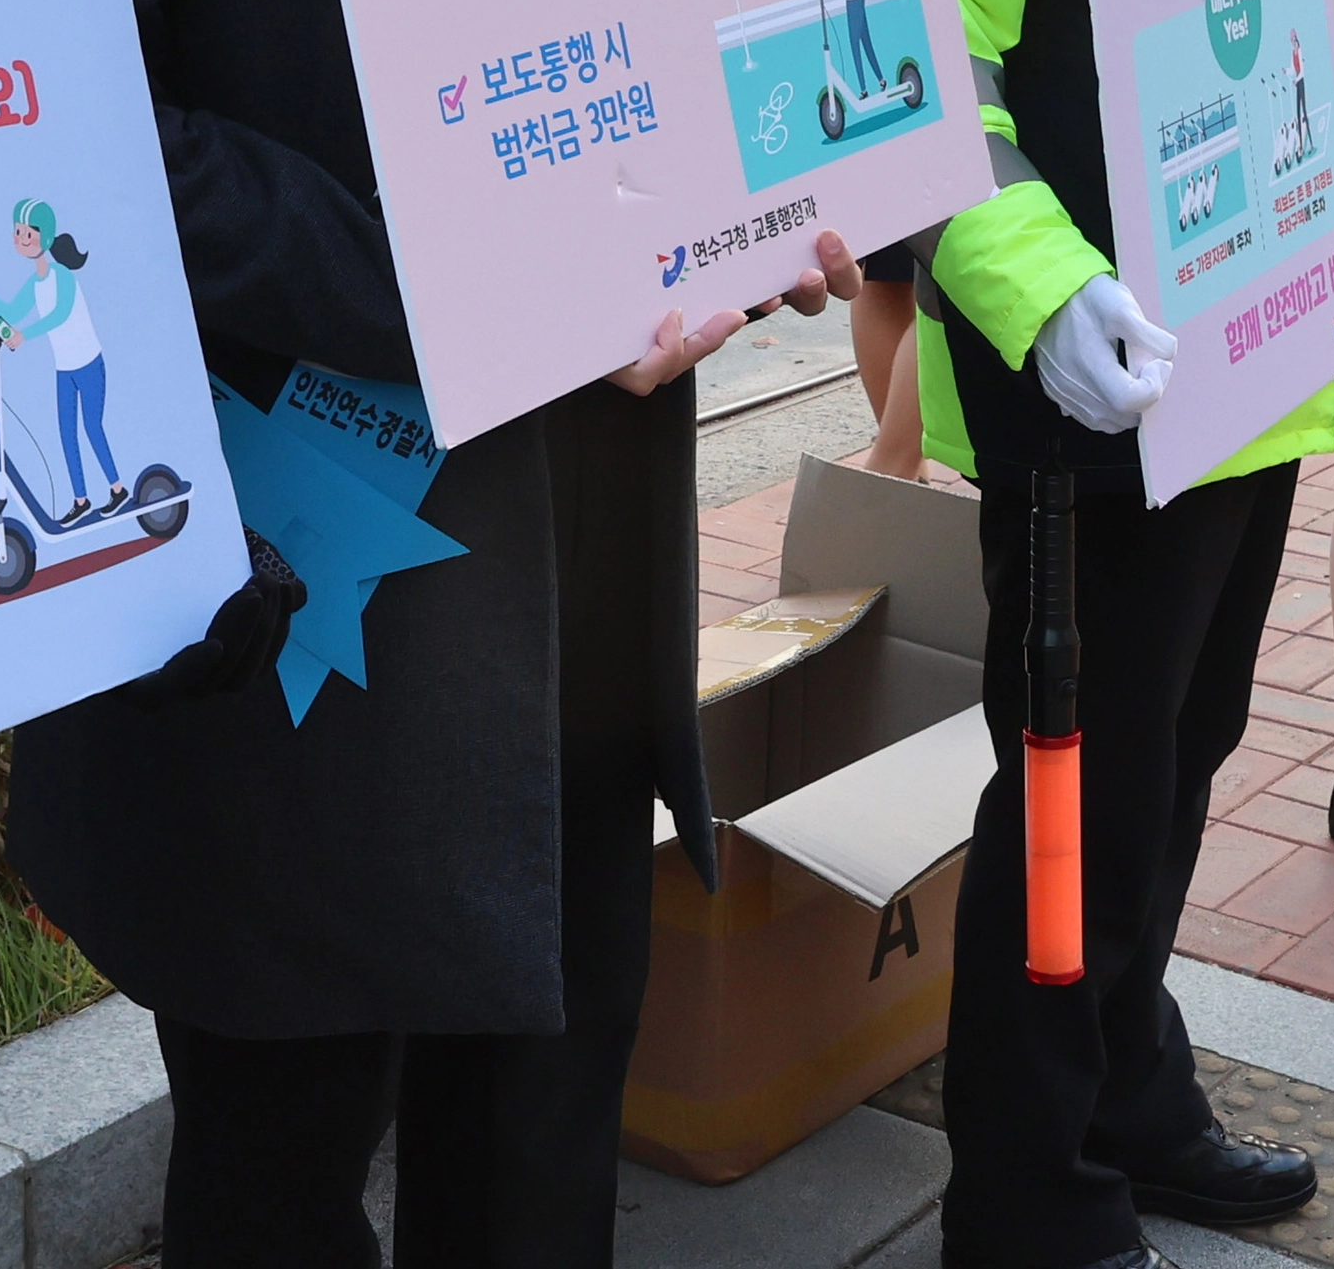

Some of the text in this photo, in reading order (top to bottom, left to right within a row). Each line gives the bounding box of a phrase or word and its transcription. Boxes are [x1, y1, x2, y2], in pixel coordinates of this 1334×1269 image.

[482, 21, 631, 106] 보도통행 시
[1223, 13, 1249, 44] Yes!
[492, 81, 658, 180] 범칙금 3만원
[692, 195, 818, 270] 연수구청 교통행정과
[1312, 195, 1326, 217] 주차
[1196, 227, 1252, 275] 가장자리에 주차
[1225, 306, 1263, 365] 함께
[1262, 262, 1328, 338] 안전하고
